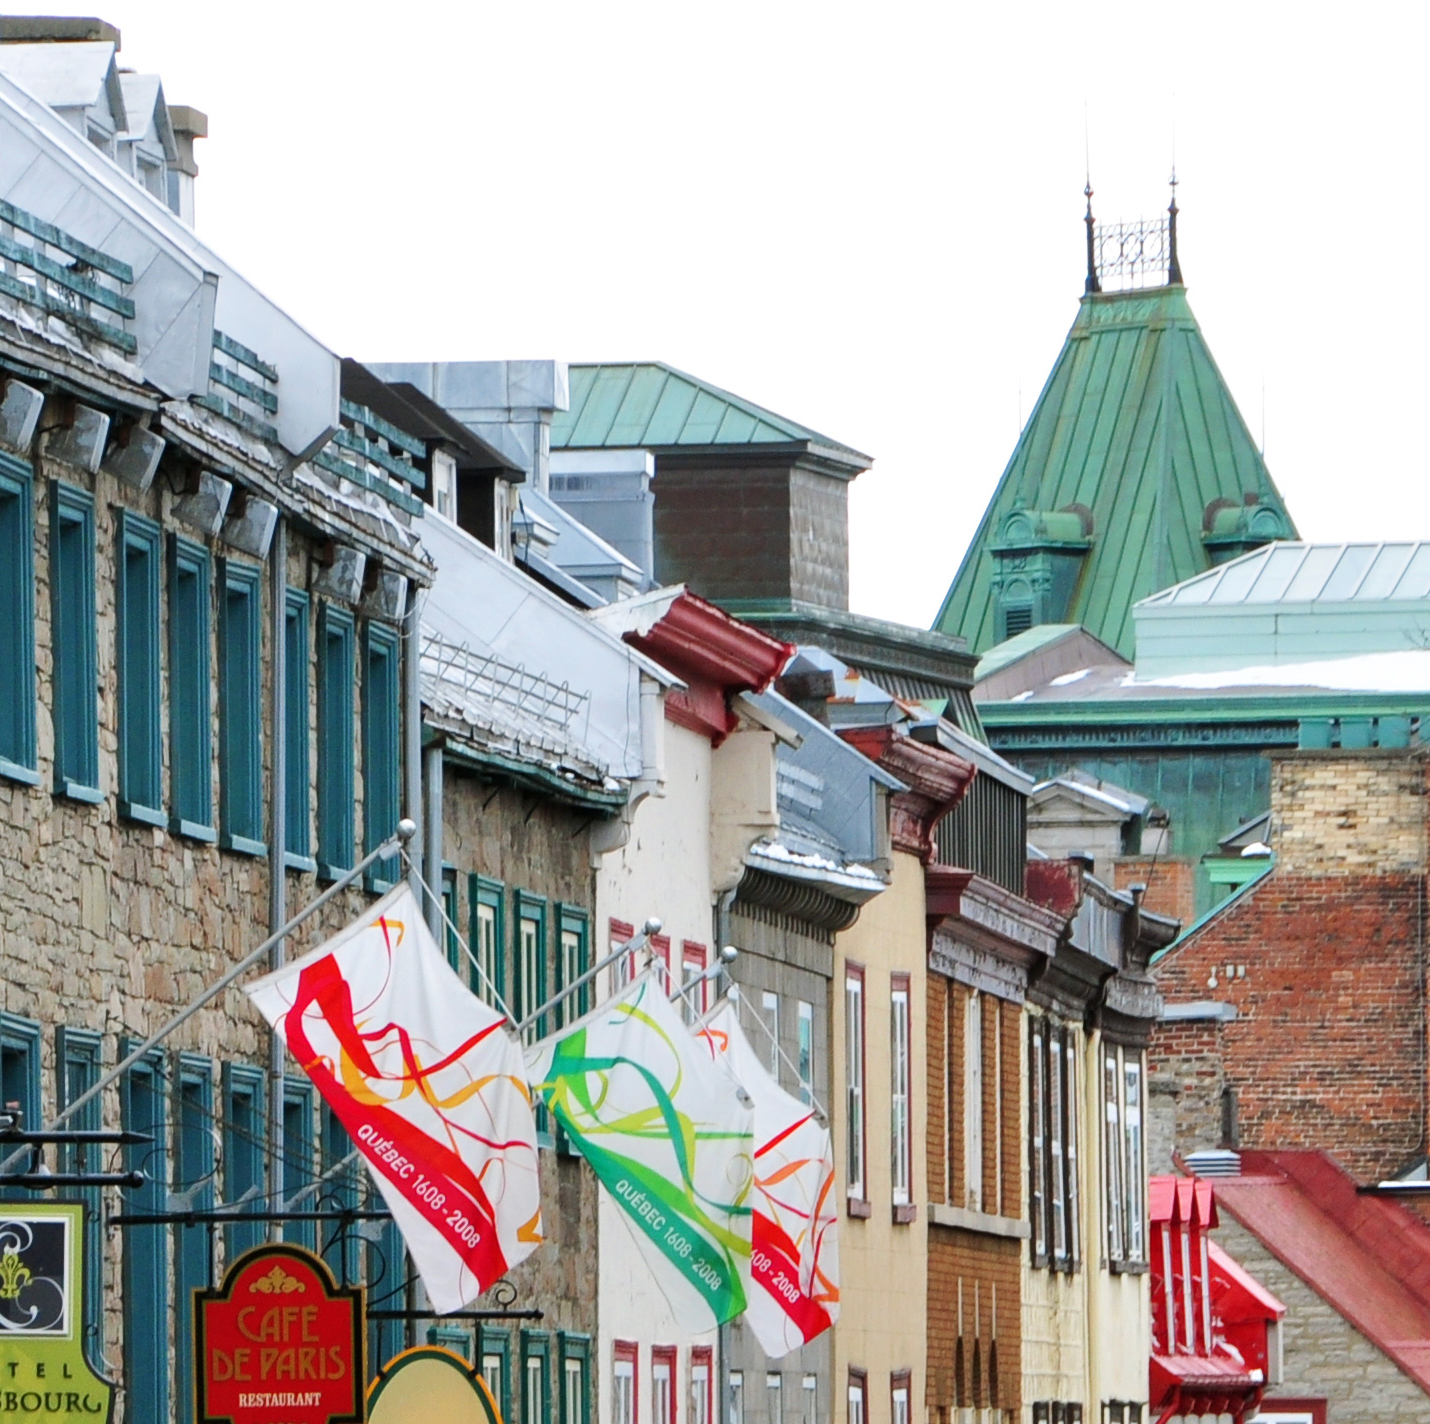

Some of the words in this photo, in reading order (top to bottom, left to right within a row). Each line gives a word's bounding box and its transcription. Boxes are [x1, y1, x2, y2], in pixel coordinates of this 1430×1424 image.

[357, 1124, 415, 1179] QUÉBEC
[411, 1174, 446, 1210] 1608
[446, 1209, 480, 1249] 2008
[615, 1179, 665, 1230] QUÉBEC
[663, 1226, 692, 1257] 1608
[691, 1257, 722, 1291] 2008
[771, 1270, 801, 1304] 2008
[236, 1304, 319, 1342] CAFÉ
[212, 1348, 252, 1381] DE
[260, 1346, 346, 1380] PARIS
[238, 1392, 322, 1407] RESTAURANT
